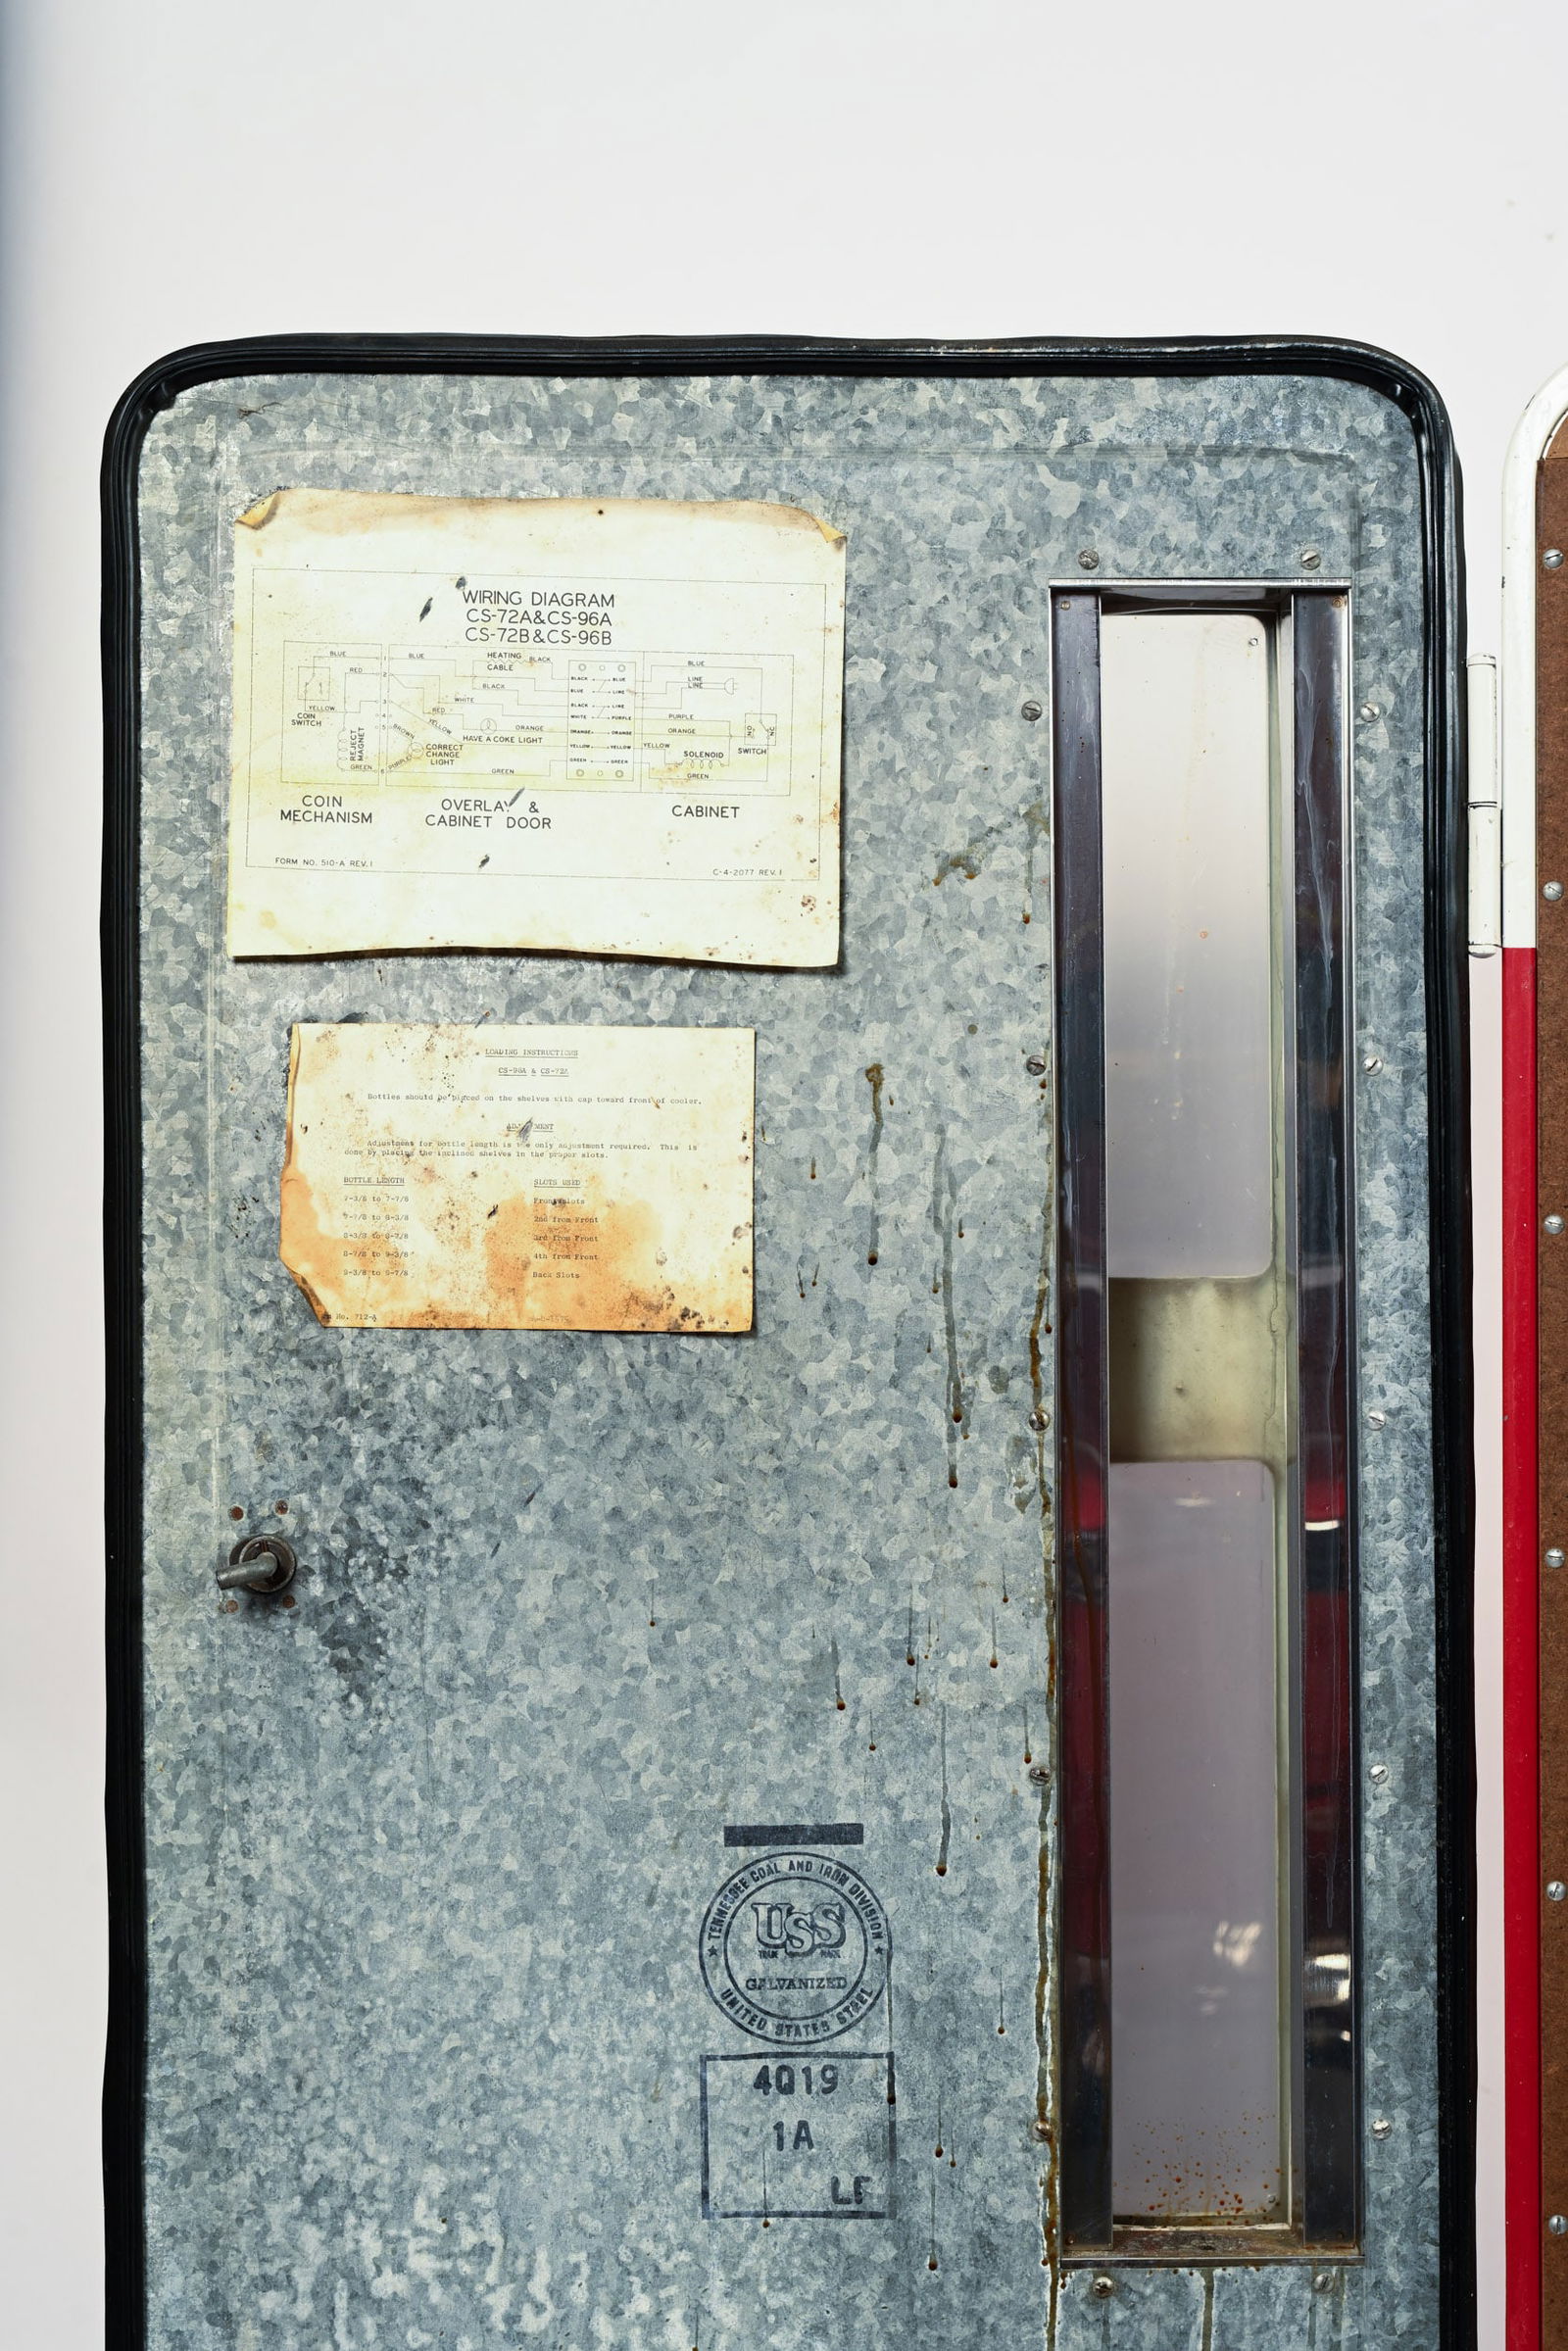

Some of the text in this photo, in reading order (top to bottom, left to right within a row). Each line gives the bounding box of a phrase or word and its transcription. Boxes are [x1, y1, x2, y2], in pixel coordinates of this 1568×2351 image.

[463, 590, 615, 608] WIRING DIAGRAM
[393, 723, 415, 740] BROWN
[428, 718, 452, 735] YELLOW
[747, 725, 753, 736] NO
[302, 795, 342, 808] COIN
[441, 799, 539, 813] OVERLAY &
[280, 809, 372, 824] MECHANISM
[671, 805, 740, 818] CABINET
[425, 814, 552, 829] CABINET DOOR
[275, 857, 298, 865] FORM
[485, 1049, 578, 1058] LOADING INSTRUCTIONS
[708, 1860, 884, 1940] TENNESSEE COAL AND IRON DIVISION
[751, 1902, 847, 1958] USS
[745, 1977, 848, 1991] GALVANIZED
[719, 1987, 874, 2038] UNITED STATES STEEL
